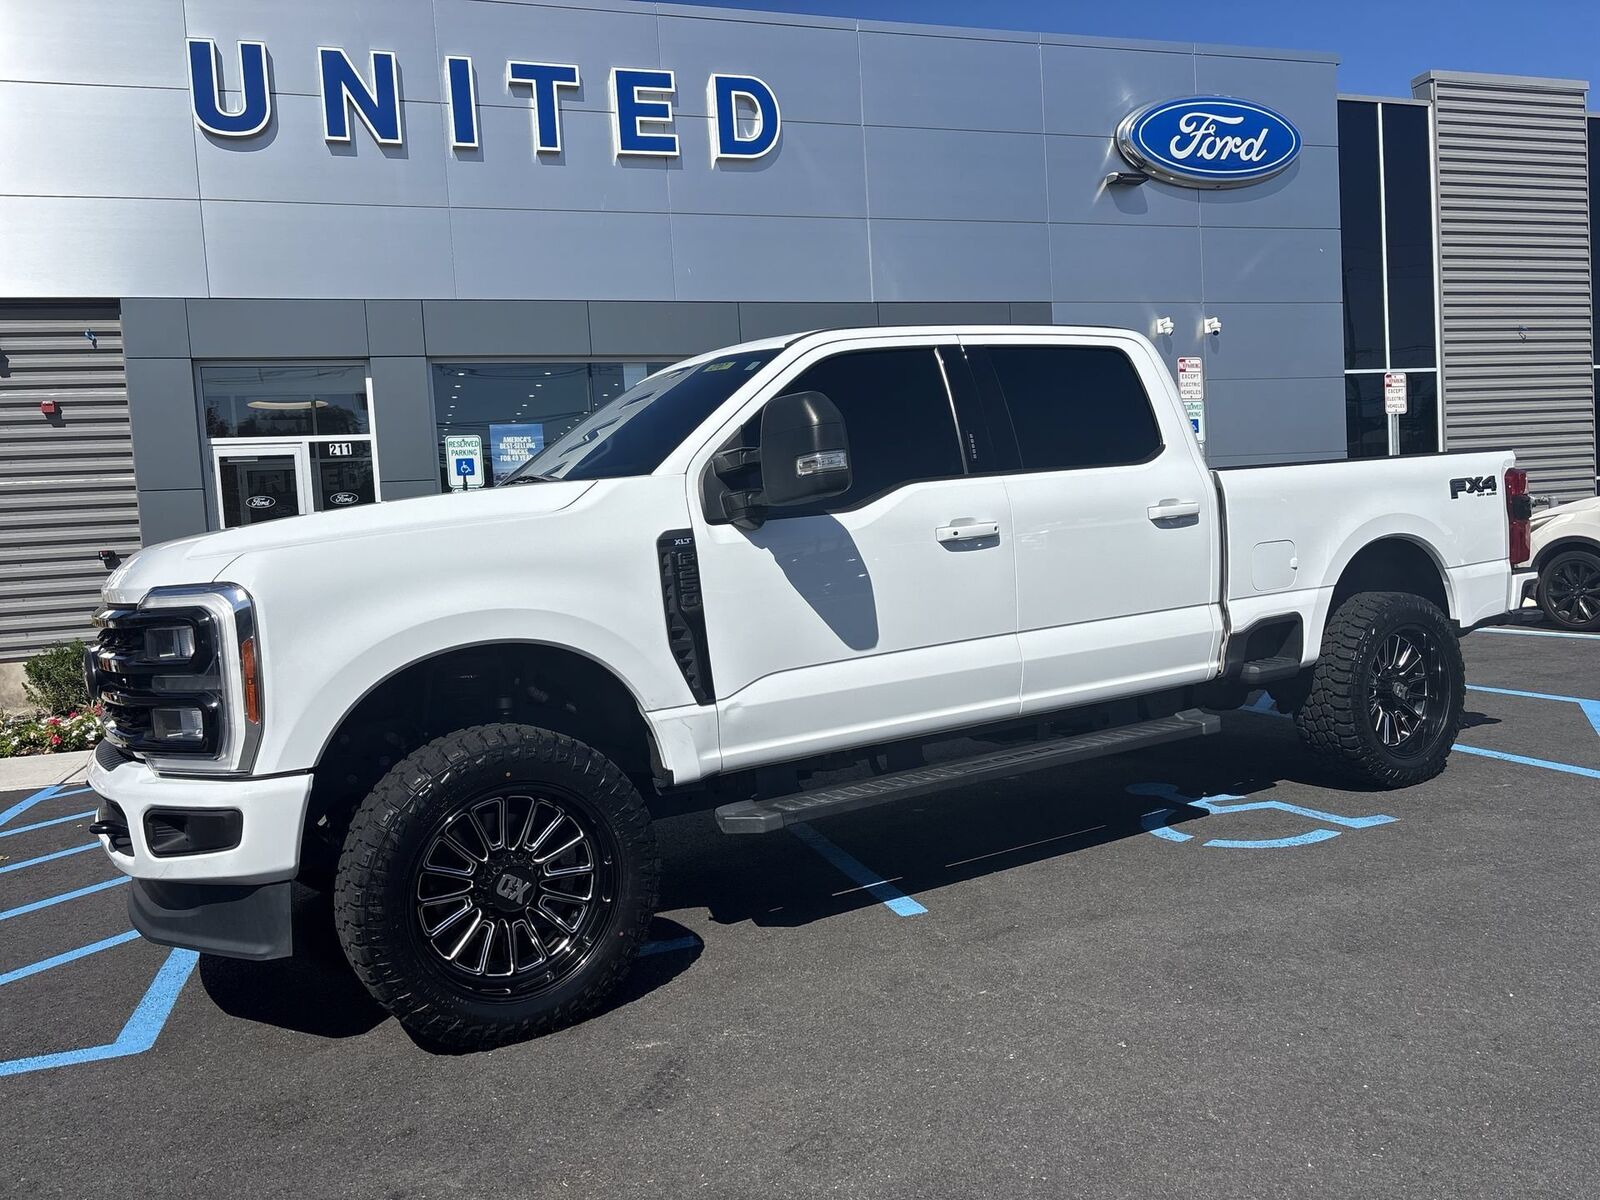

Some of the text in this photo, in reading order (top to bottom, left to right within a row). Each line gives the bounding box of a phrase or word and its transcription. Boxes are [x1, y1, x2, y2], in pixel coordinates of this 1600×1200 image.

[185, 37, 782, 162] UNITED
[1169, 112, 1269, 161] Ford
[448, 440, 480, 448] RESERVED
[499, 442, 536, 450] BEST-SELLING
[329, 443, 352, 456] 211
[1449, 475, 1497, 500] FX4
[251, 497, 270, 506] Ford
[335, 494, 353, 503] Ford
[674, 538, 692, 546] XLT
